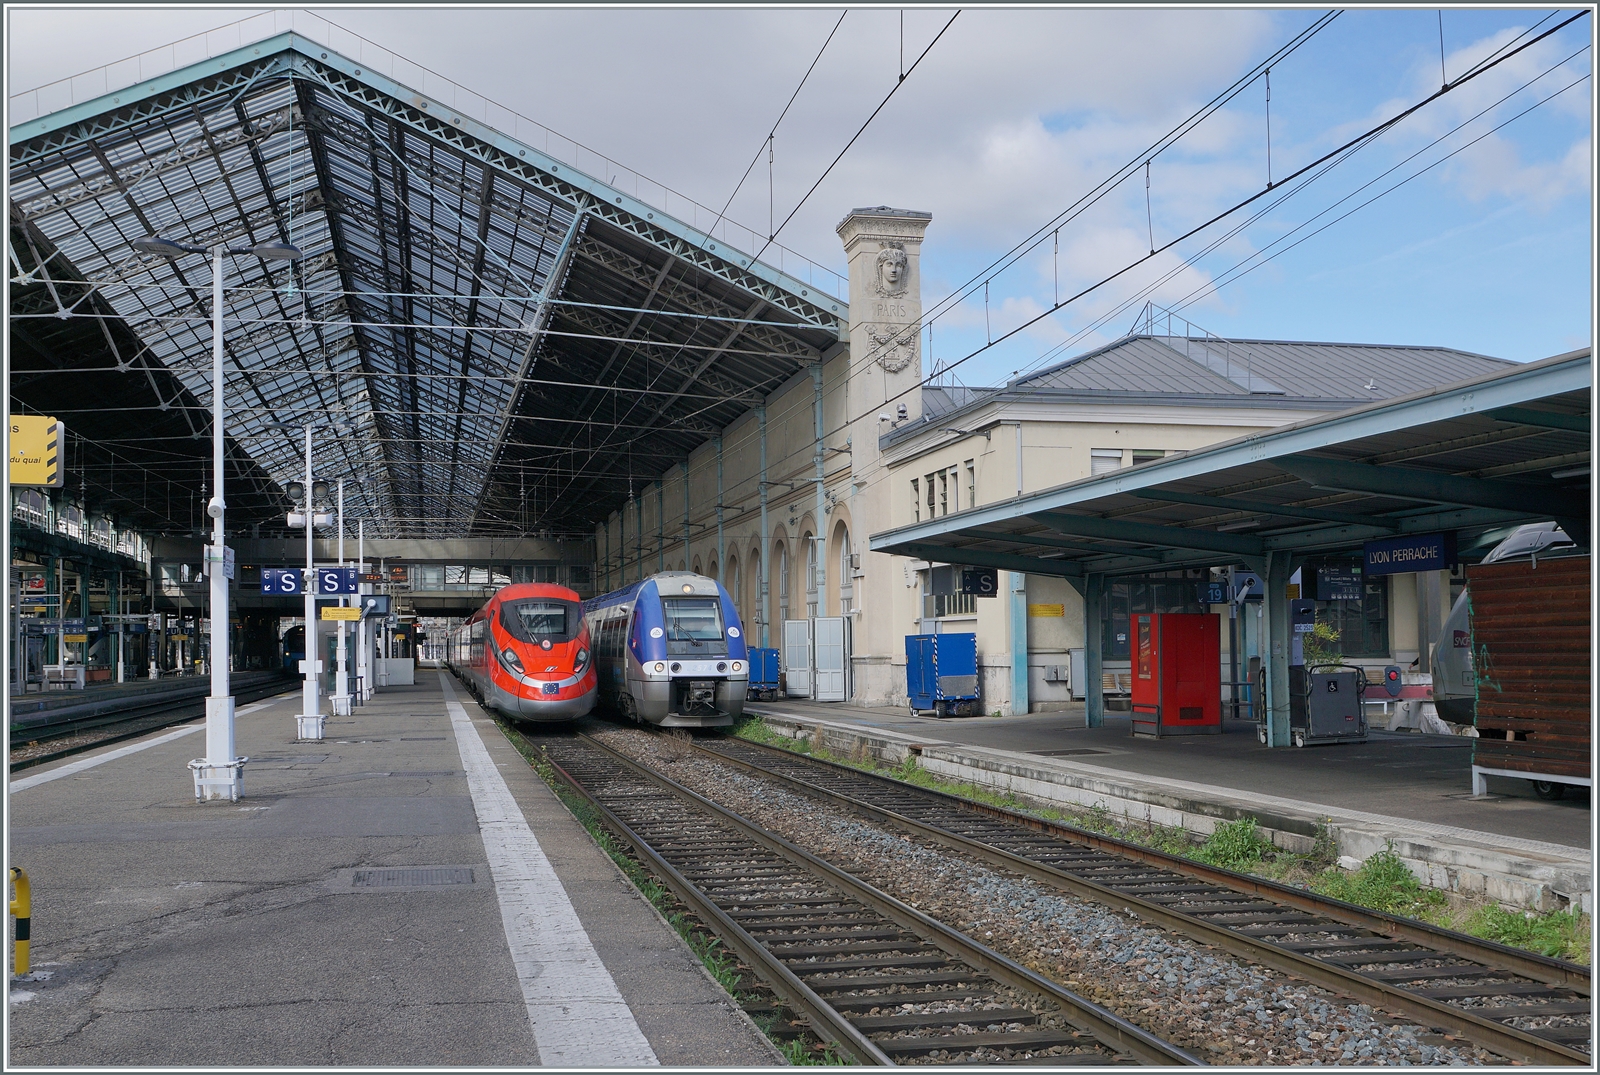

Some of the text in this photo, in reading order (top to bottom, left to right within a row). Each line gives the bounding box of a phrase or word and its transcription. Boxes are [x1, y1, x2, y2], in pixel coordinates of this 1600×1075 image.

[877, 304, 906, 317] PARIS
[1369, 546, 1438, 564] LYON PERRACHE
[281, 573, 296, 592] S
[324, 573, 339, 592] S
[980, 575, 993, 592] S
[1208, 589, 1222, 600] 19
[1454, 637, 1470, 646] SNCF
